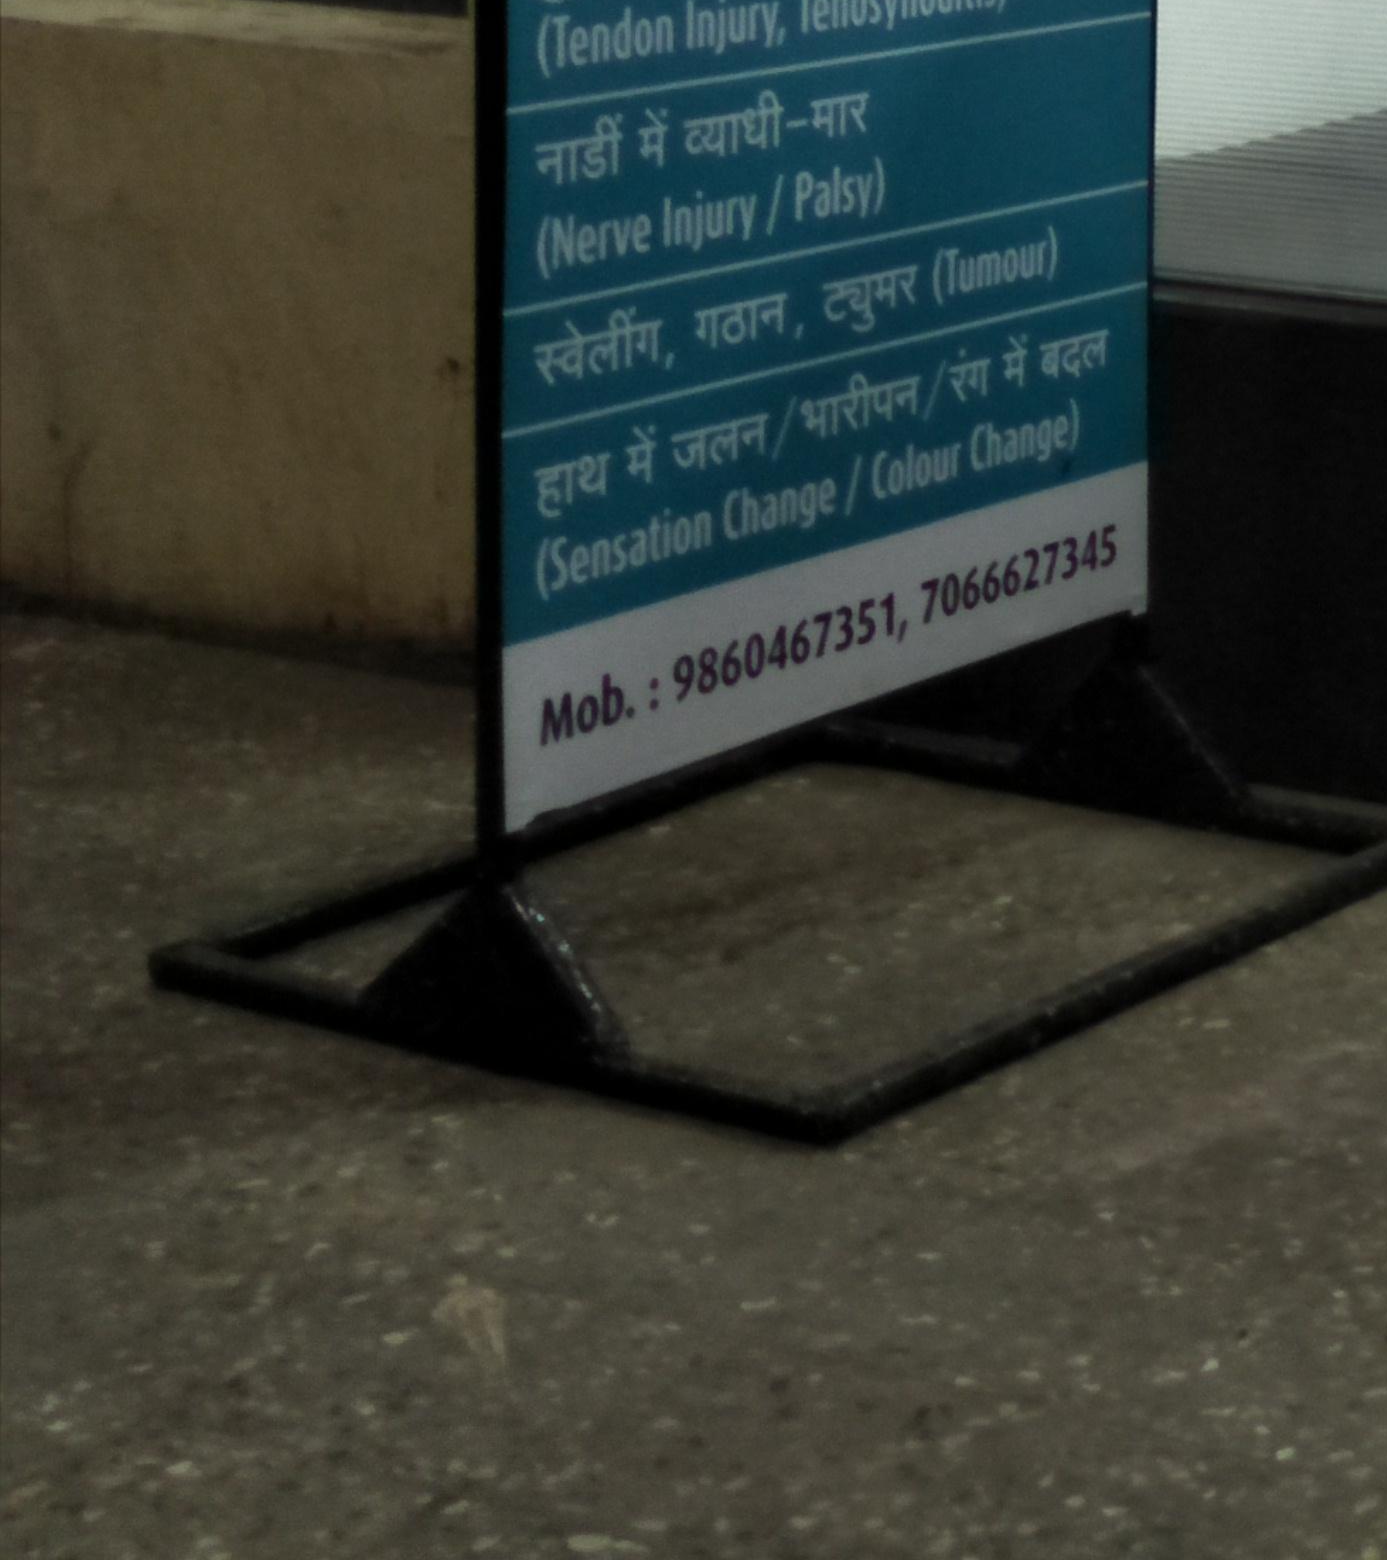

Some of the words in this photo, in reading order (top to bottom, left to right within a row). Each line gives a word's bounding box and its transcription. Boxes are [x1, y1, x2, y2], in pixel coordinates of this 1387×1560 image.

[536, 6, 675, 80] (Tendon
[638, 107, 668, 168] में
[537, 213, 652, 281] (Nerve
[663, 190, 757, 253] Injury
[766, 173, 784, 236] /
[793, 156, 886, 223] Palsy)
[821, 264, 919, 333] ट्युमर
[932, 225, 1059, 306] (Tumour)
[534, 452, 611, 519] हाथ
[625, 425, 657, 484] में
[1003, 334, 1028, 388] में
[1039, 328, 1110, 379] बदल
[536, 507, 713, 601] (Sensation
[723, 477, 837, 540] Change
[845, 454, 863, 516] /
[872, 443, 962, 499] Colour
[970, 397, 1079, 472] Change)
[539, 673, 636, 747] Mob.
[673, 593, 909, 702] 9860467351,
[919, 524, 1118, 625] 7066627345
